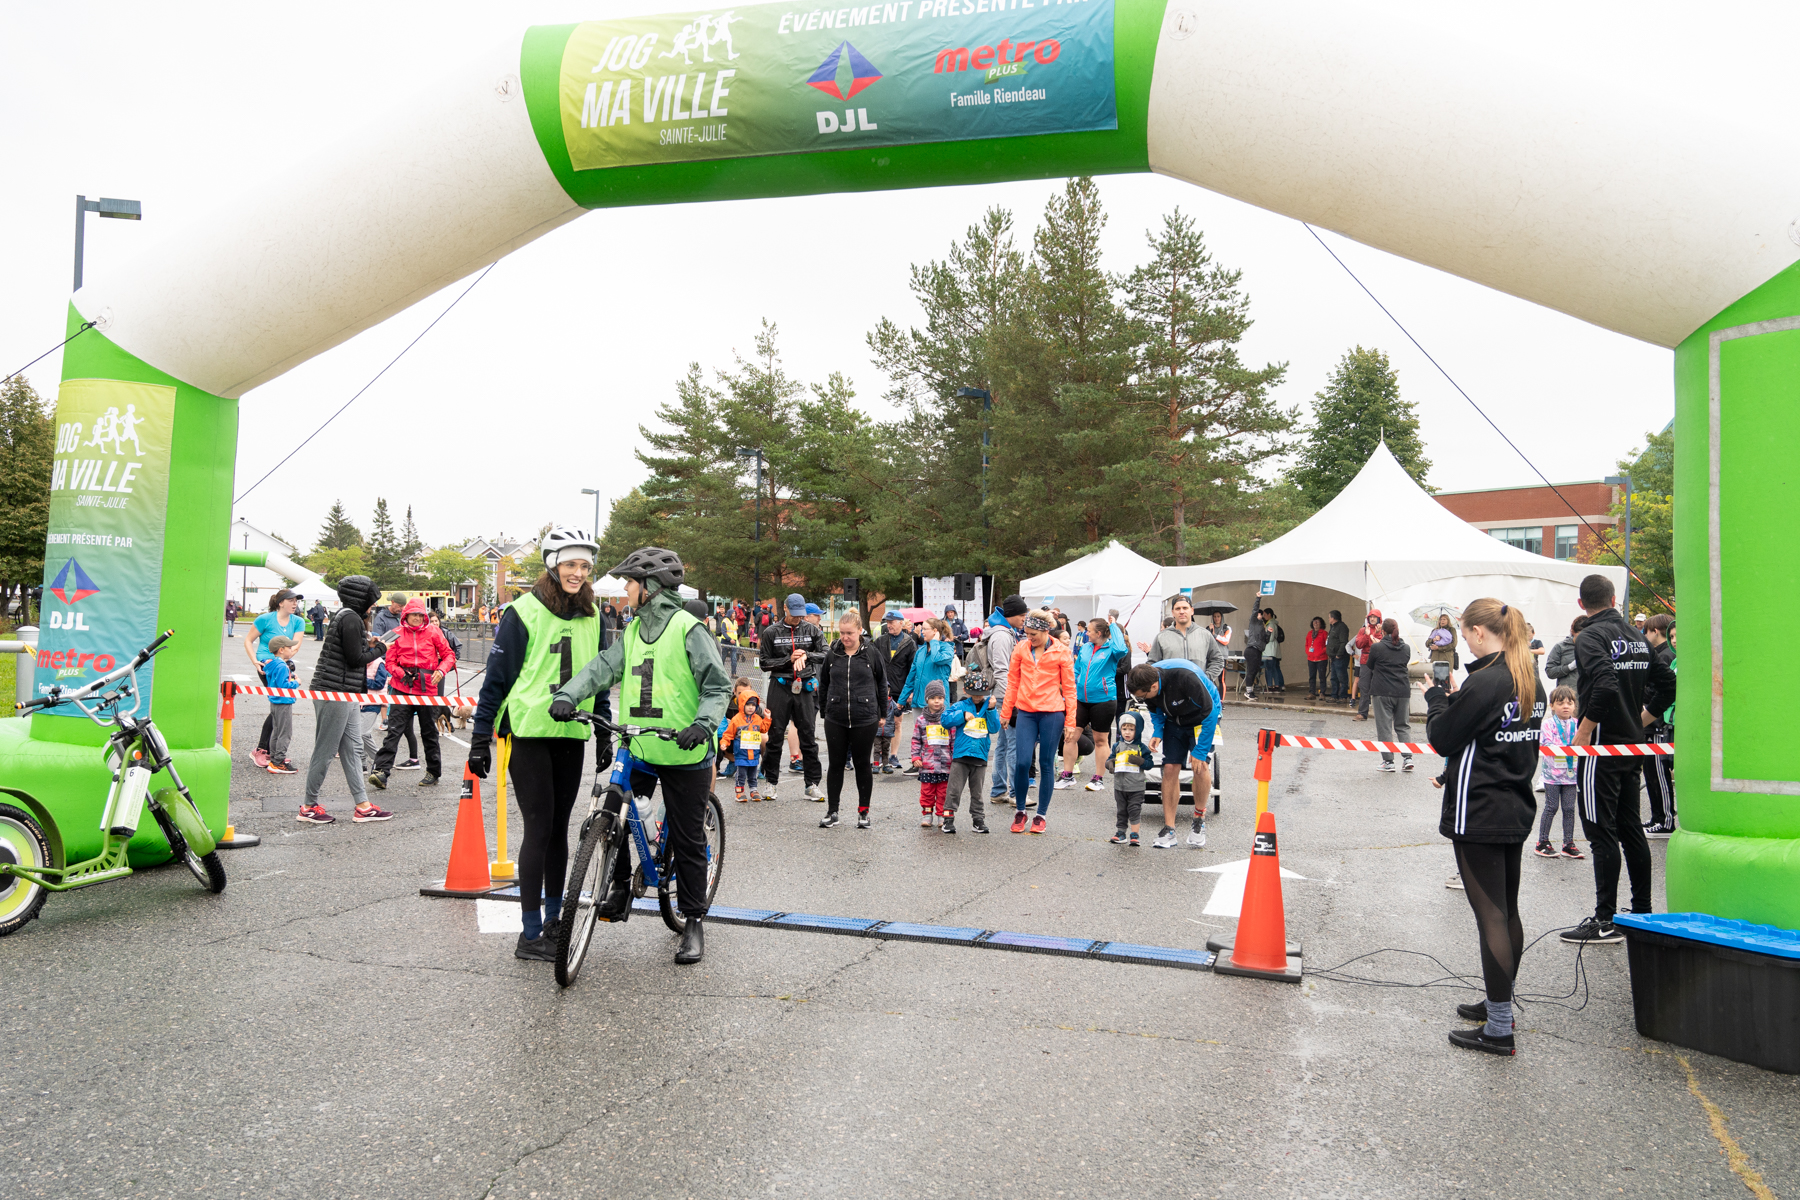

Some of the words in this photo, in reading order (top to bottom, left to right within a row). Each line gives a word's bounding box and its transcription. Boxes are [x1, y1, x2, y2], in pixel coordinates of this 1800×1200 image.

[778, 1, 913, 34] ÉVÉNEMENT
[591, 33, 659, 74] JOG
[934, 38, 1061, 74] metro
[988, 64, 1019, 79] PLUS
[581, 79, 631, 128] MA
[643, 69, 736, 123] VILLE
[950, 90, 991, 107] Famille
[993, 87, 1046, 104] Riendeau
[816, 108, 878, 134] DJL
[660, 124, 728, 146] SAINTE-JULIE
[70, 459, 142, 493] VILLE
[76, 495, 129, 509] SAINTE-JULIE
[72, 532, 112, 546] PRÉSENTÉ
[114, 537, 133, 547] PAR
[49, 611, 90, 631] DJL
[36, 648, 116, 673] metro
[549, 636, 573, 694] 1
[630, 658, 663, 718] 1
[130, 769, 135, 777] 6
[24, 819, 42, 839] POWER
[40, 841, 50, 867] TREAD
